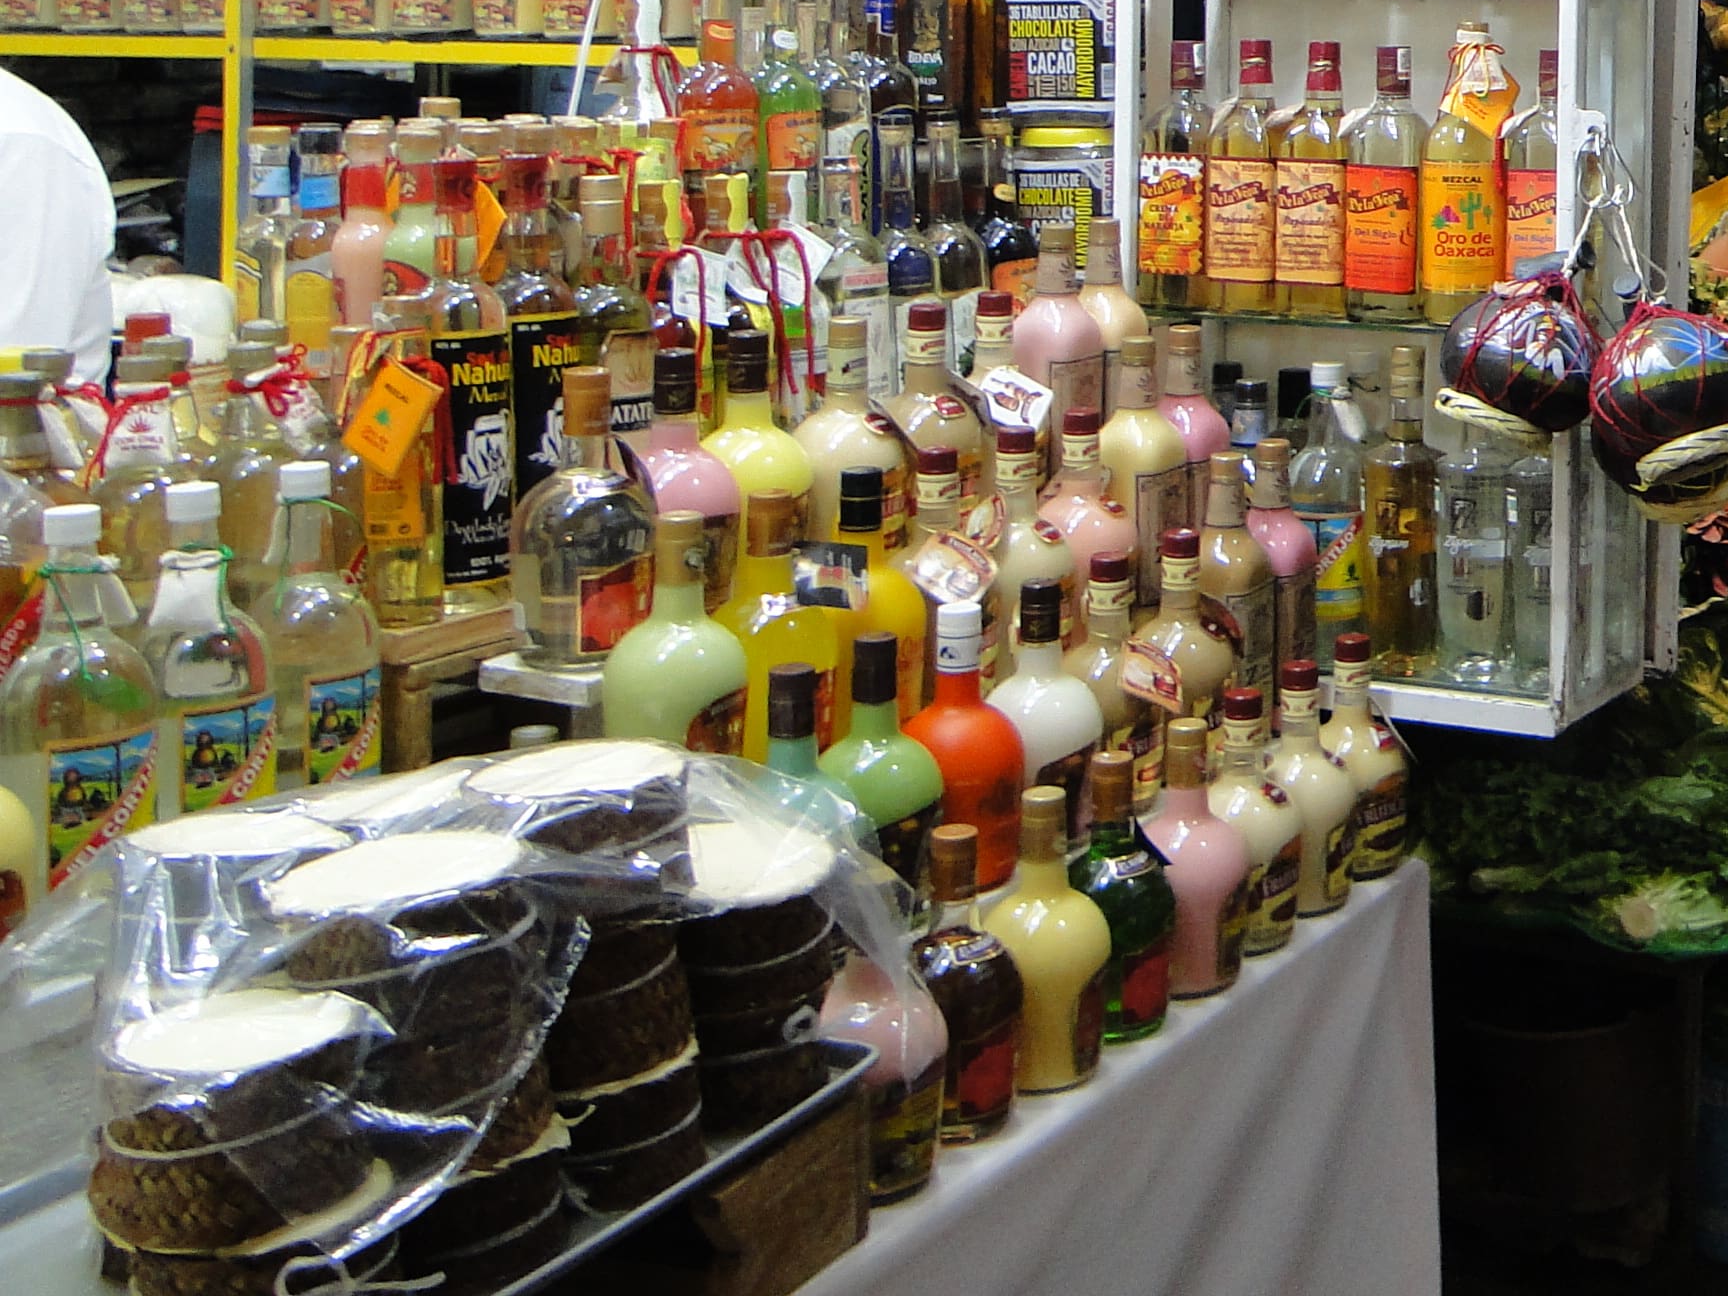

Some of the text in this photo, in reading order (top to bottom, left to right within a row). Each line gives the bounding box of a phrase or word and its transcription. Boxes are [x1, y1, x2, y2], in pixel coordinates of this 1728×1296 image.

[1020, 5, 1069, 19] TABLILLAS
[1069, 5, 1080, 19] DE
[1010, 20, 1075, 37] CHOCOLATE
[1028, 52, 1075, 75] CACAO
[1076, 19, 1094, 98] MAYORDOMO
[1020, 187, 1075, 205] CHOCOLATE
[1075, 188, 1092, 267] MAYORDOMO
[1437, 232, 1492, 244] Oro de
[1434, 244, 1495, 257] Oaxaca
